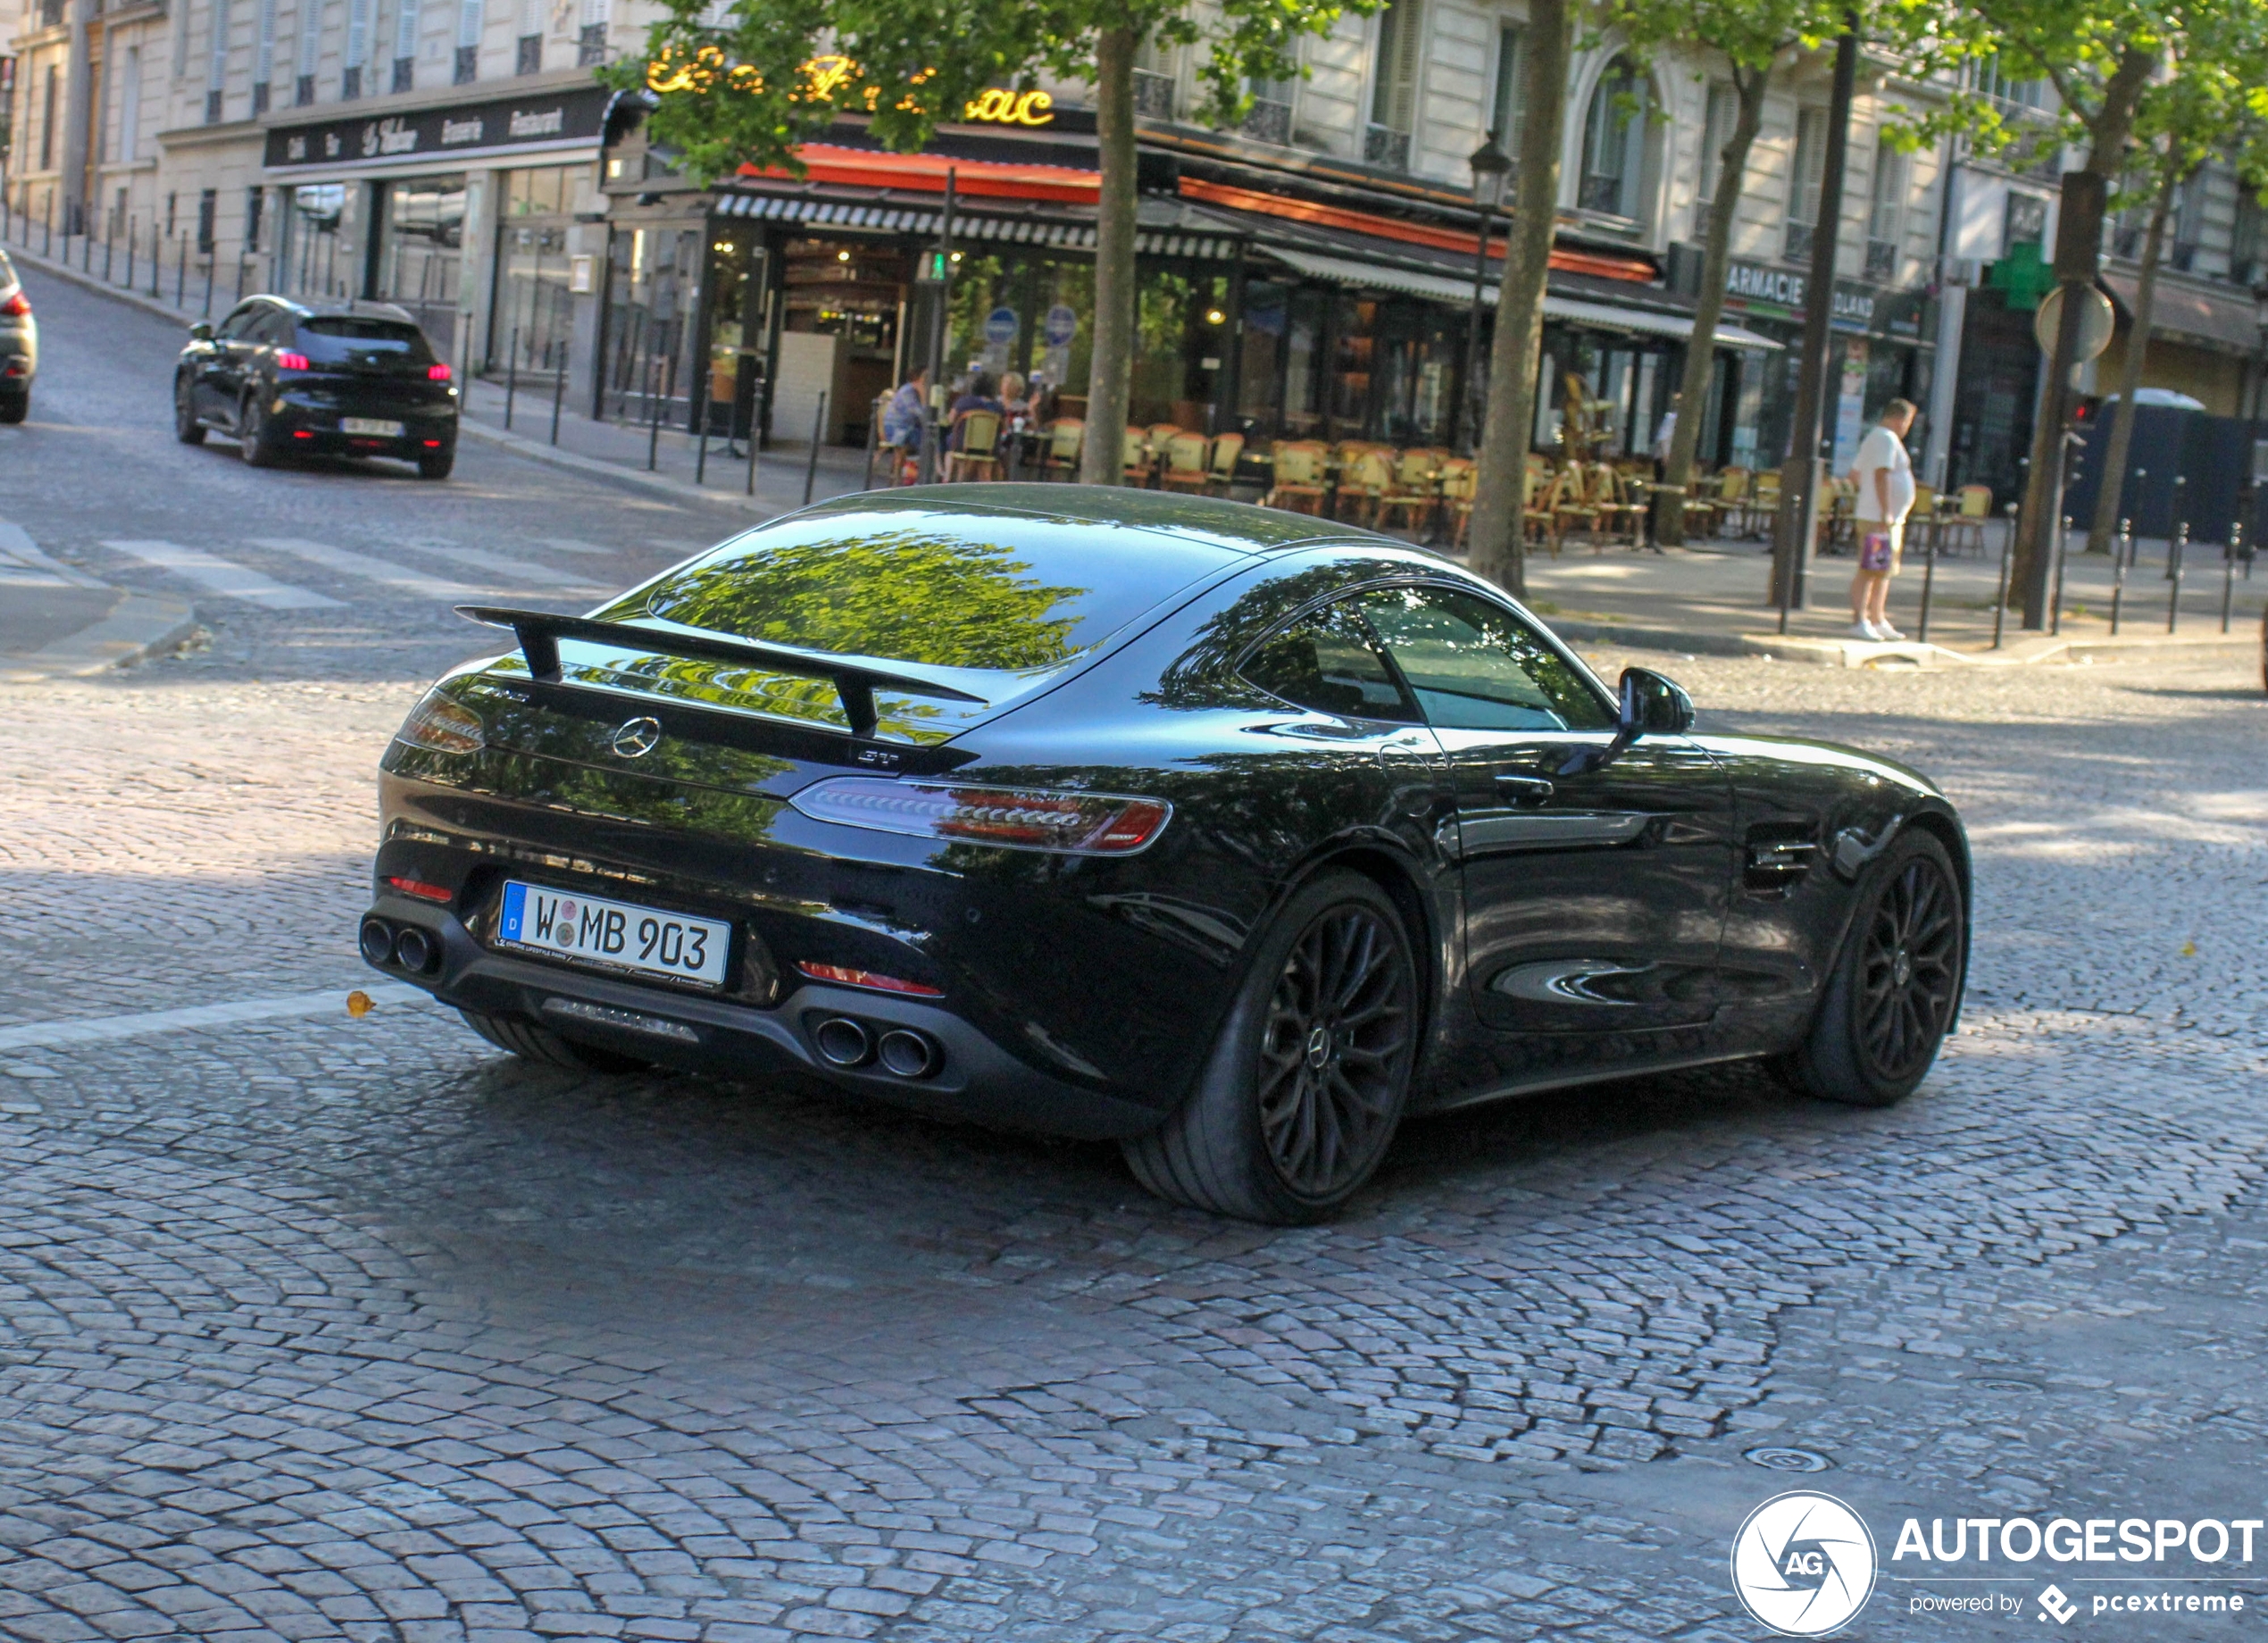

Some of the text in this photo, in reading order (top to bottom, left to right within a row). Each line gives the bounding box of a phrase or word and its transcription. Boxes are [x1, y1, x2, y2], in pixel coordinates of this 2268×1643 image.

[1725, 265, 1805, 306] ARMACIE
[508, 917, 517, 930] D
[537, 895, 709, 971] W MB 903
